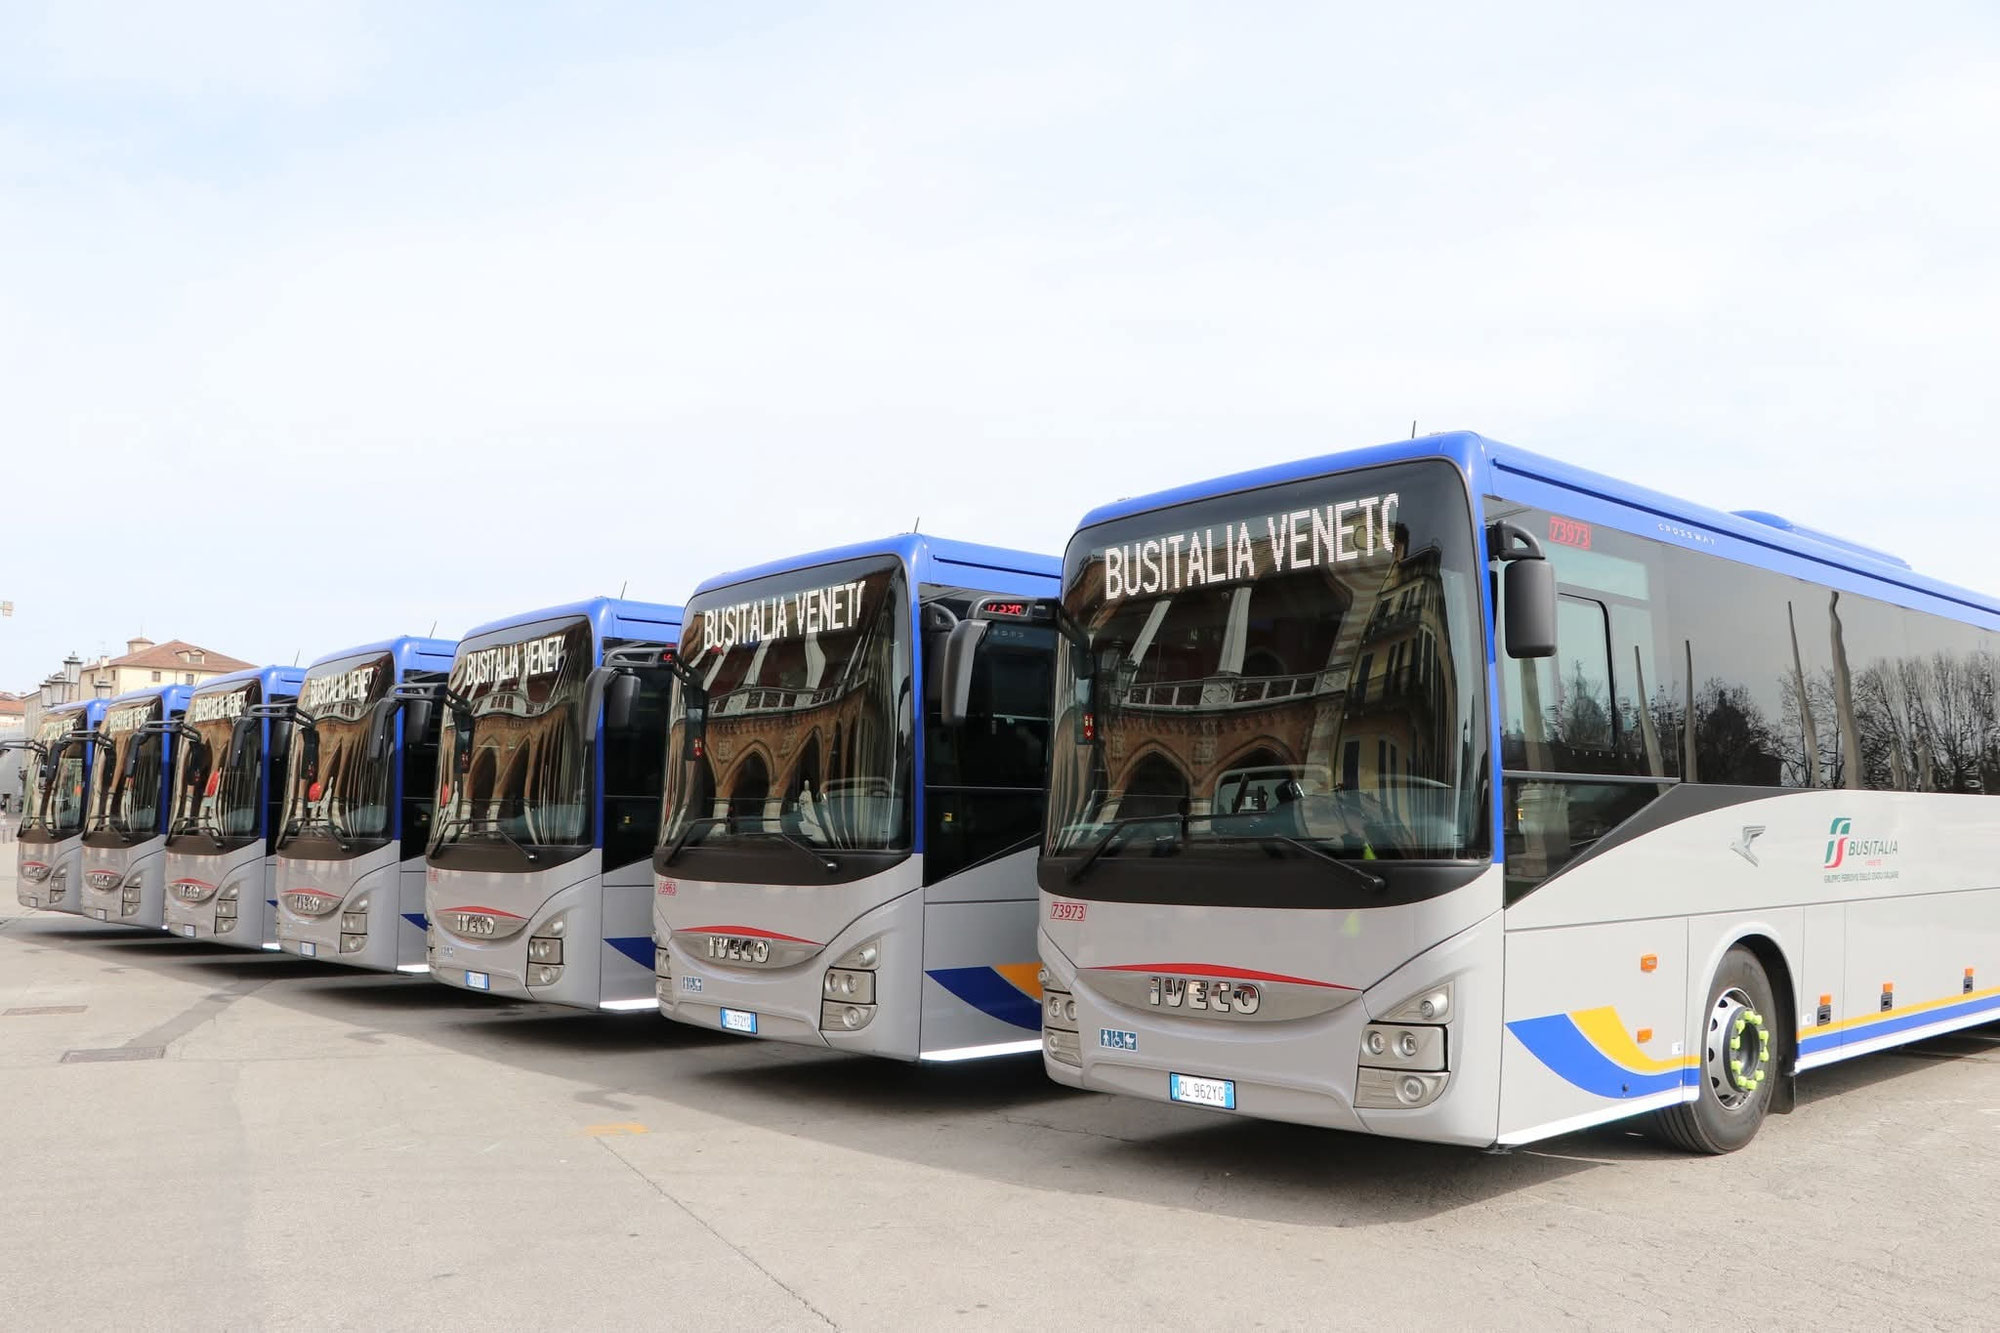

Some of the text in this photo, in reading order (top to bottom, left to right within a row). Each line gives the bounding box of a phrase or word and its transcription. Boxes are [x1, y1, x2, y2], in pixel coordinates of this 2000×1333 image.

[1657, 522, 1716, 546] CROSSWAY
[1105, 522, 1255, 600] BUSITALIA
[703, 596, 788, 651] BUSITALIA
[466, 644, 519, 686] BUSITALIA
[1848, 841, 1898, 856] BUSITALIA
[457, 914, 495, 935] IVECO
[1052, 904, 1085, 920] 73973
[709, 936, 769, 963] IVECO
[1150, 976, 1261, 1014] IVECO
